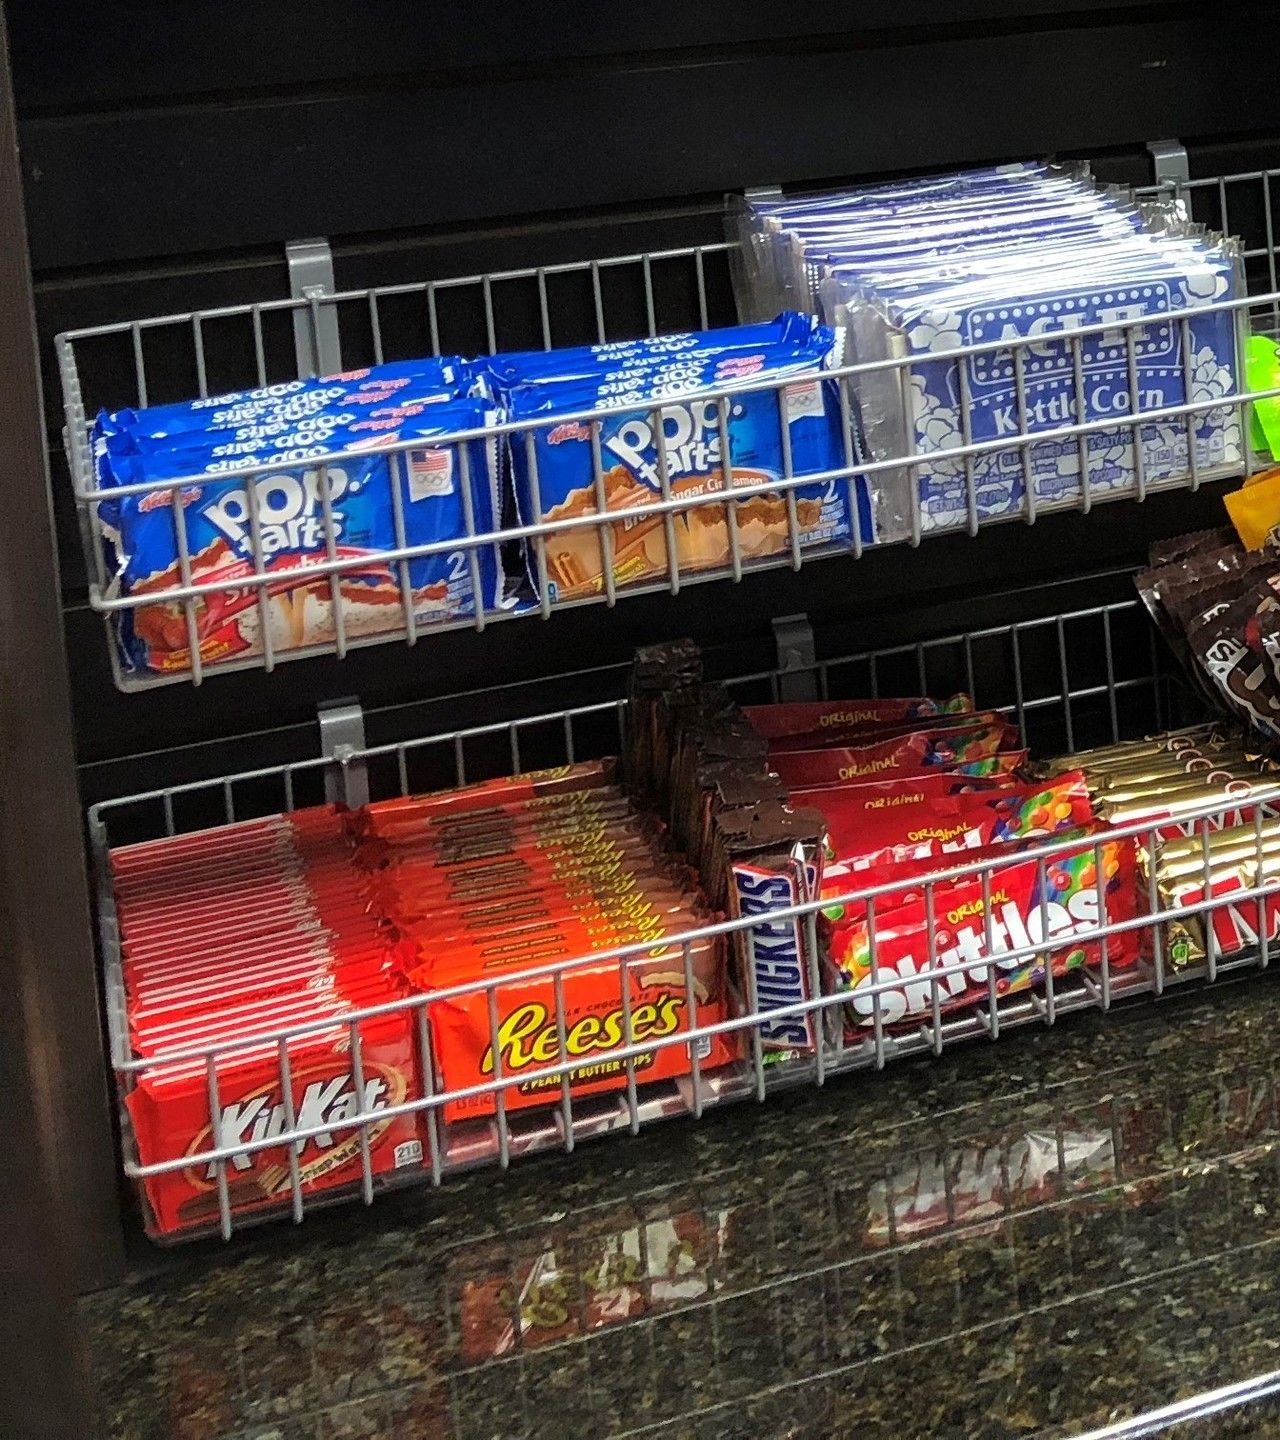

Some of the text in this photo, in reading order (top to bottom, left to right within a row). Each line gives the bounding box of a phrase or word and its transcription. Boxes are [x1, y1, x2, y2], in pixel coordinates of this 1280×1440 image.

[992, 386, 1165, 437] Kettle Corn
[736, 872, 807, 1044] SNICKERS
[854, 889, 1107, 1026] Skittles
[481, 994, 684, 1074] Reese's
[578, 1064, 619, 1079] BUTTER
[396, 1143, 421, 1159] 210
